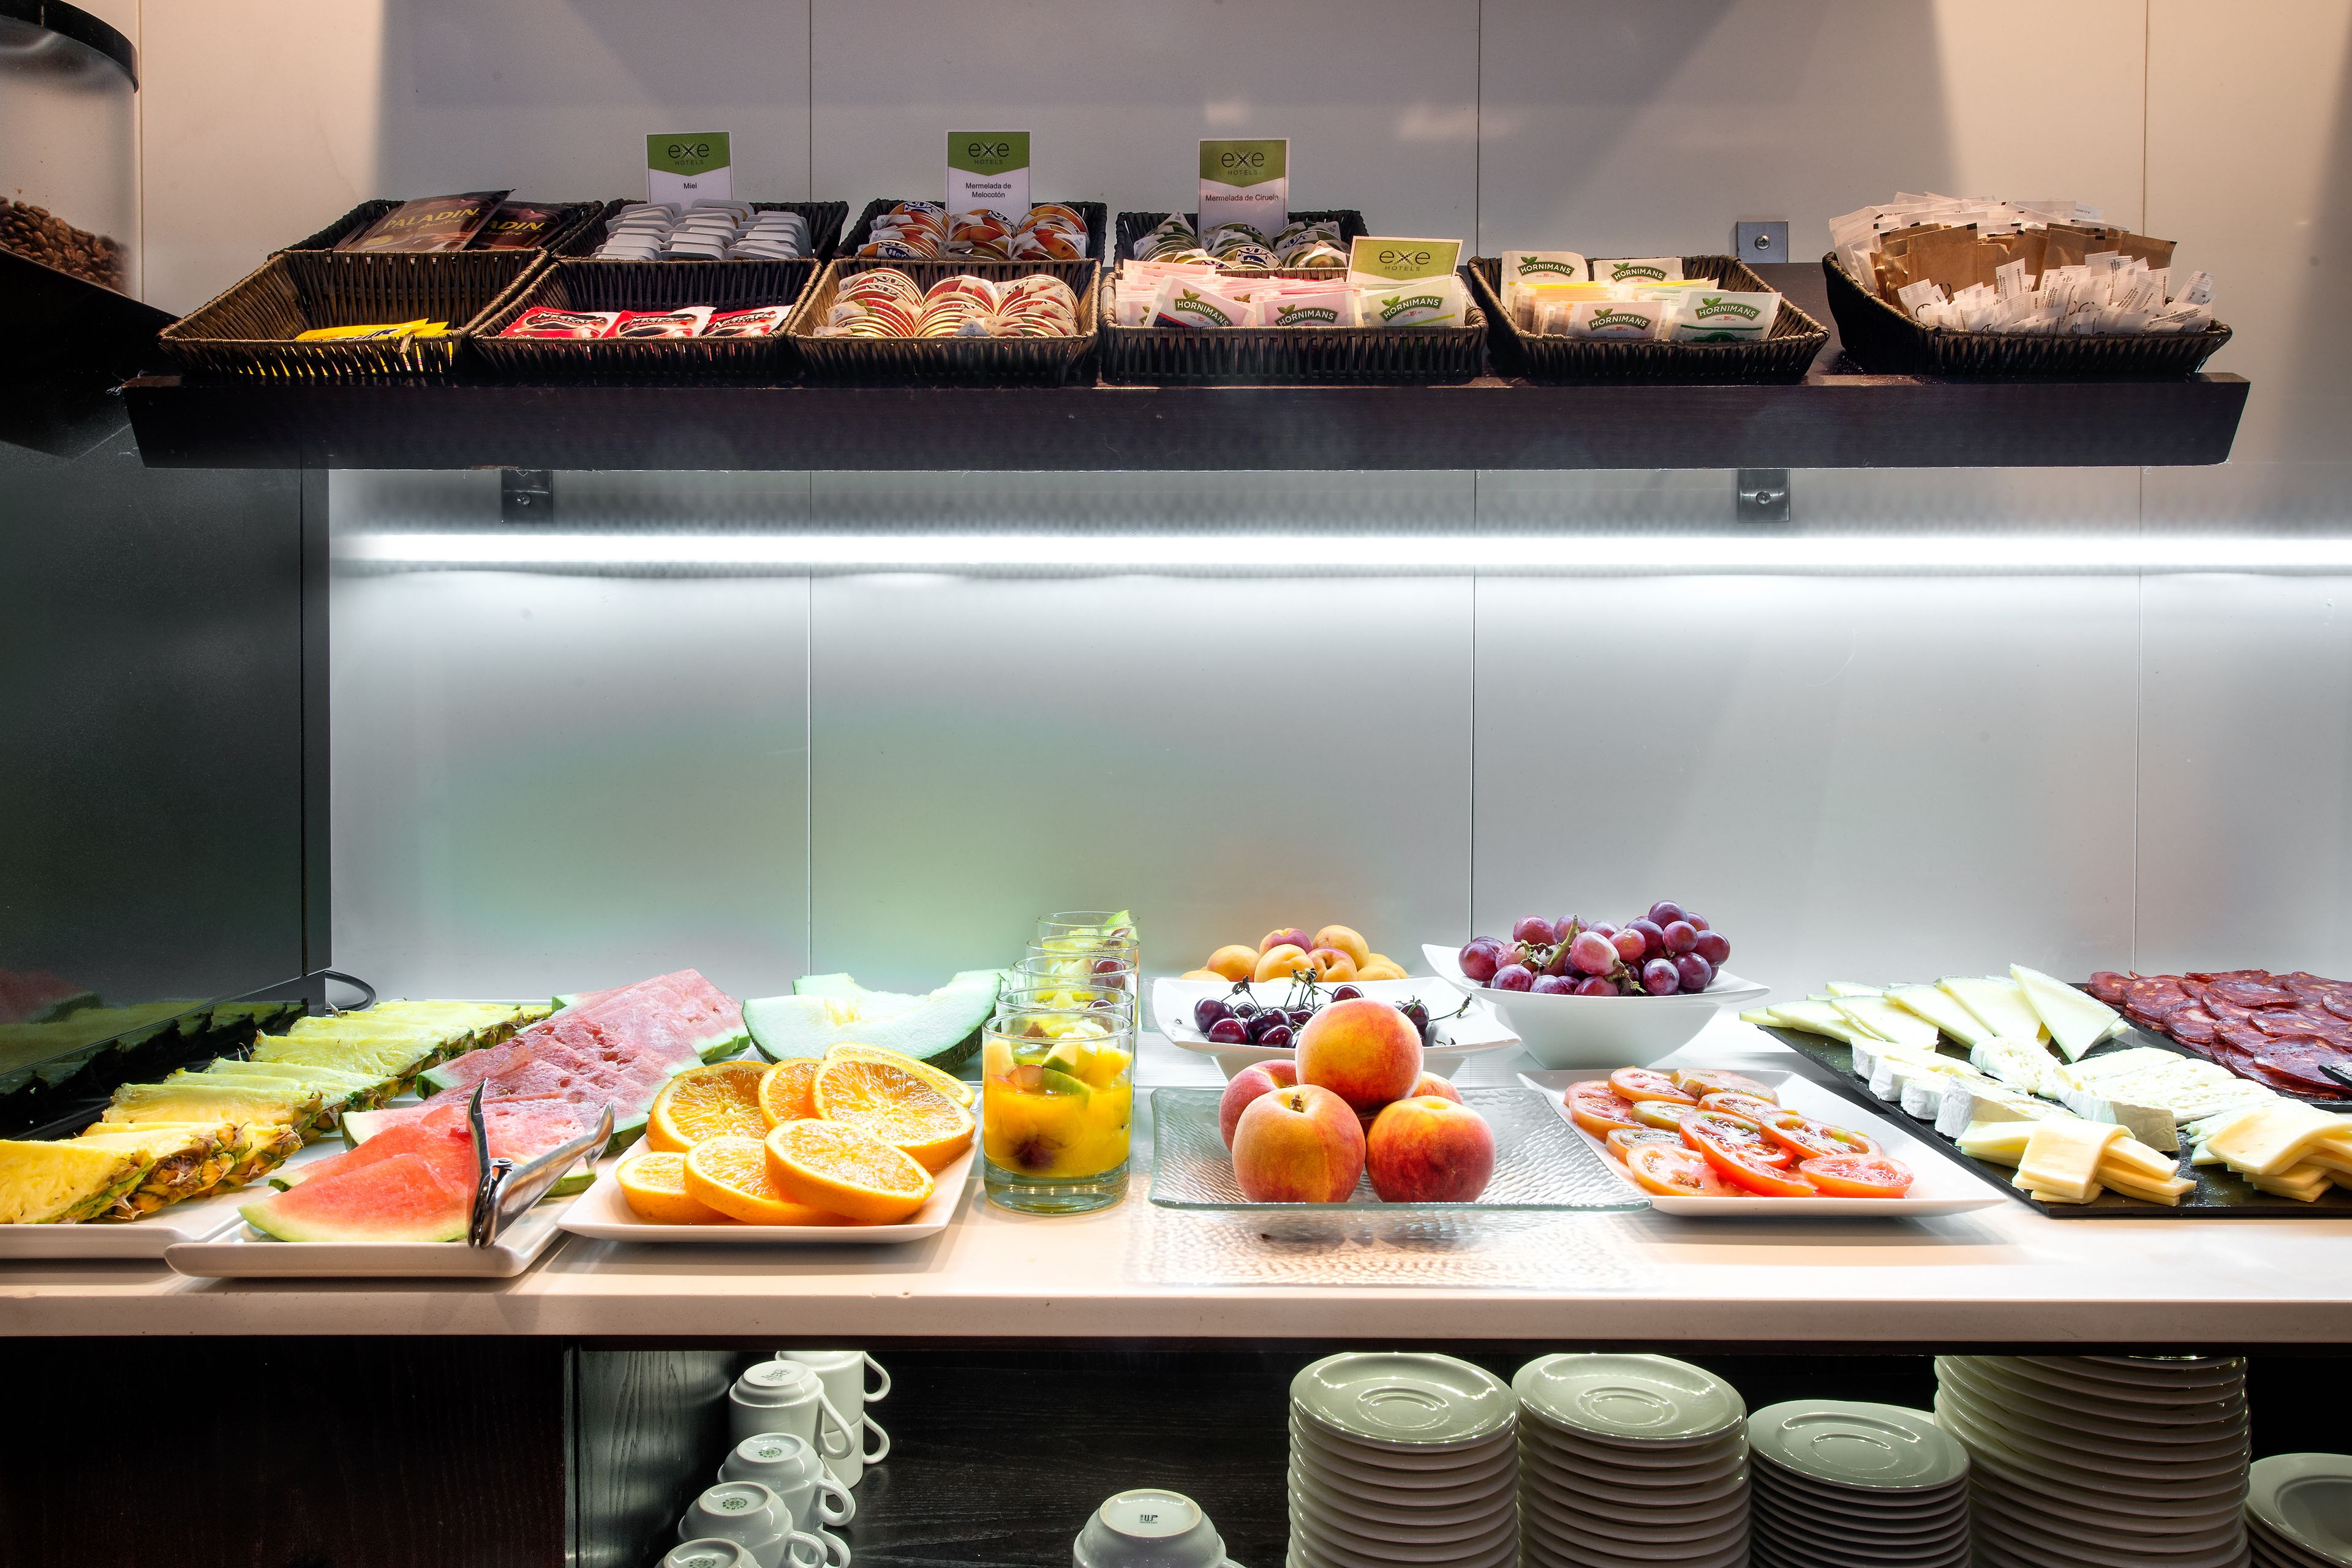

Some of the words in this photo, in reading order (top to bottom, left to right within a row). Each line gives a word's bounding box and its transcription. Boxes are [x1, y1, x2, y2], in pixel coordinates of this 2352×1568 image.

[668, 143, 709, 159] exe
[968, 142, 1009, 158] exe
[1222, 151, 1264, 169] exe
[383, 208, 479, 229] PALADIN
[1379, 250, 1431, 265] exe
[1521, 263, 1571, 274] HORNIMANS
[1615, 268, 1664, 279] HORNIMANS
[1177, 301, 1229, 326] HORNIMANS
[1384, 298, 1439, 318] HORNIMANS
[1699, 305, 1756, 318] HORNIMANS
[1278, 311, 1334, 326] HORNIMANS
[1591, 315, 1647, 328] HORNIMANS
